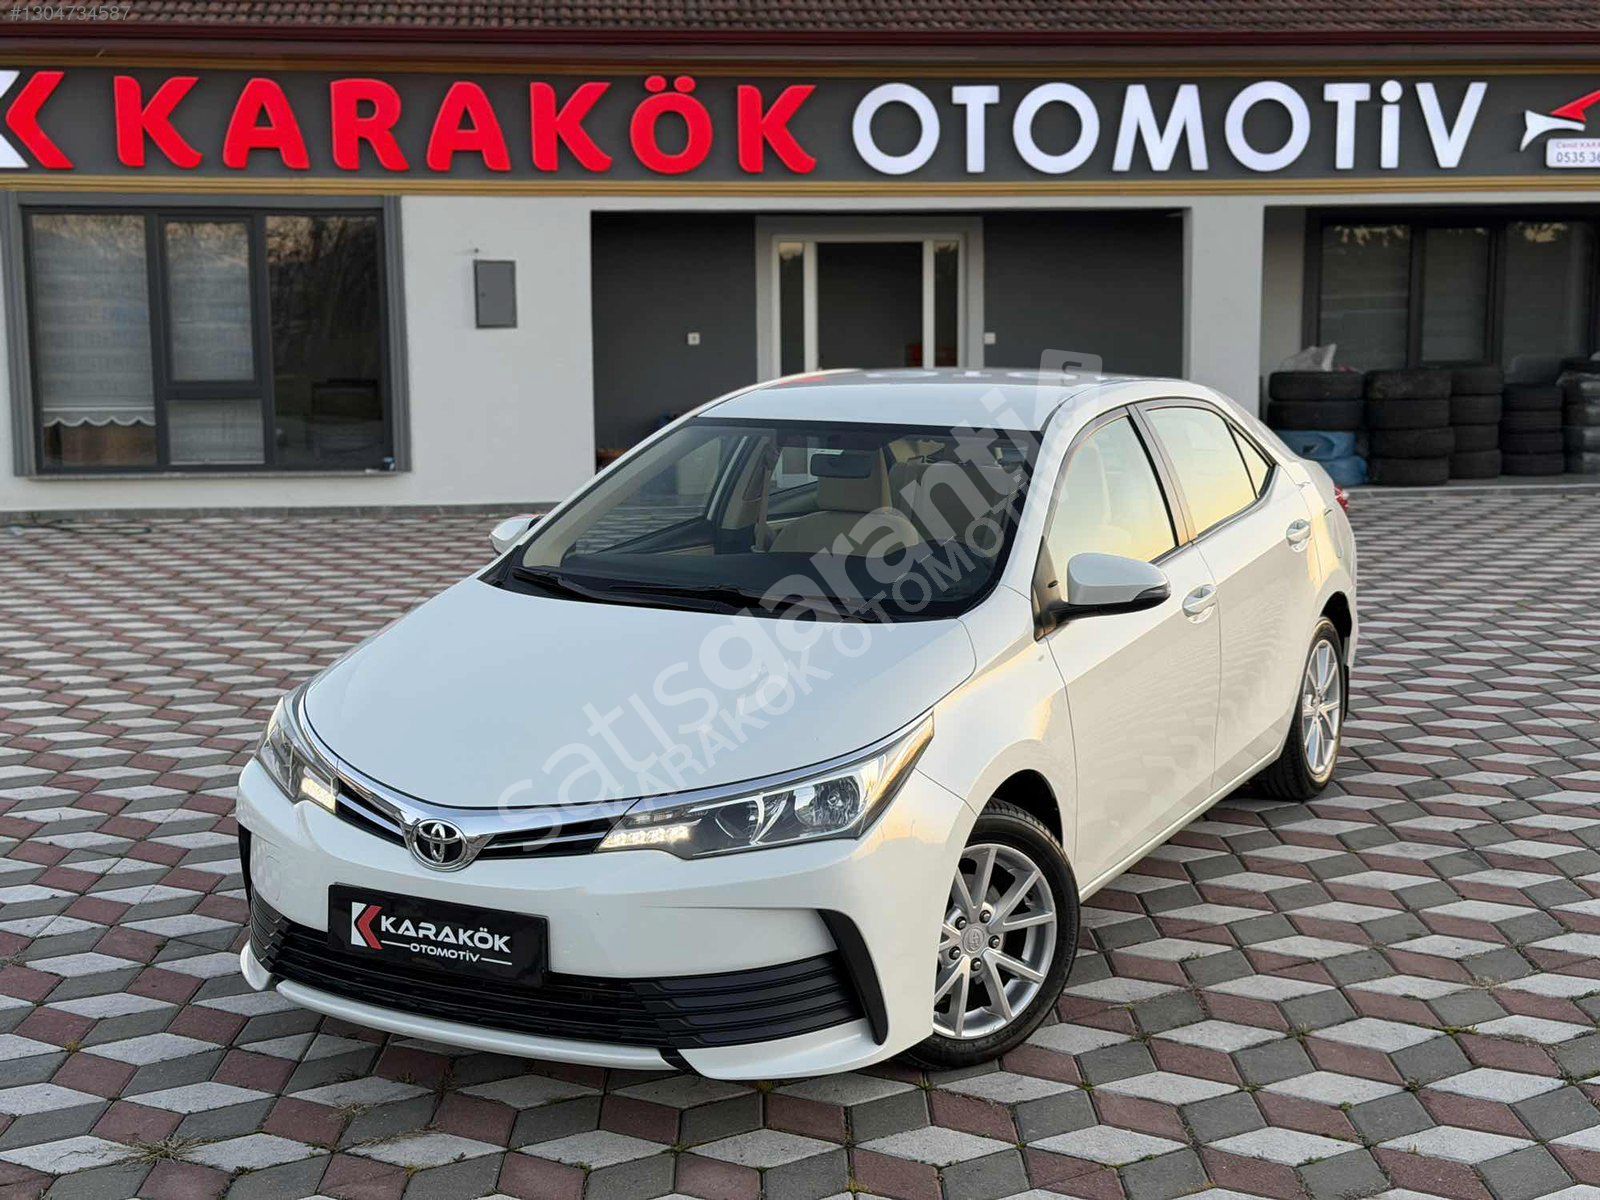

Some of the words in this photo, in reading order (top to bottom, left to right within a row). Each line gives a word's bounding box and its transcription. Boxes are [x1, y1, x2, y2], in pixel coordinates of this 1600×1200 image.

[113, 74, 817, 173] KARAKÖK
[1556, 152, 1586, 163] 0535
[380, 915, 511, 953] KARAKÖK
